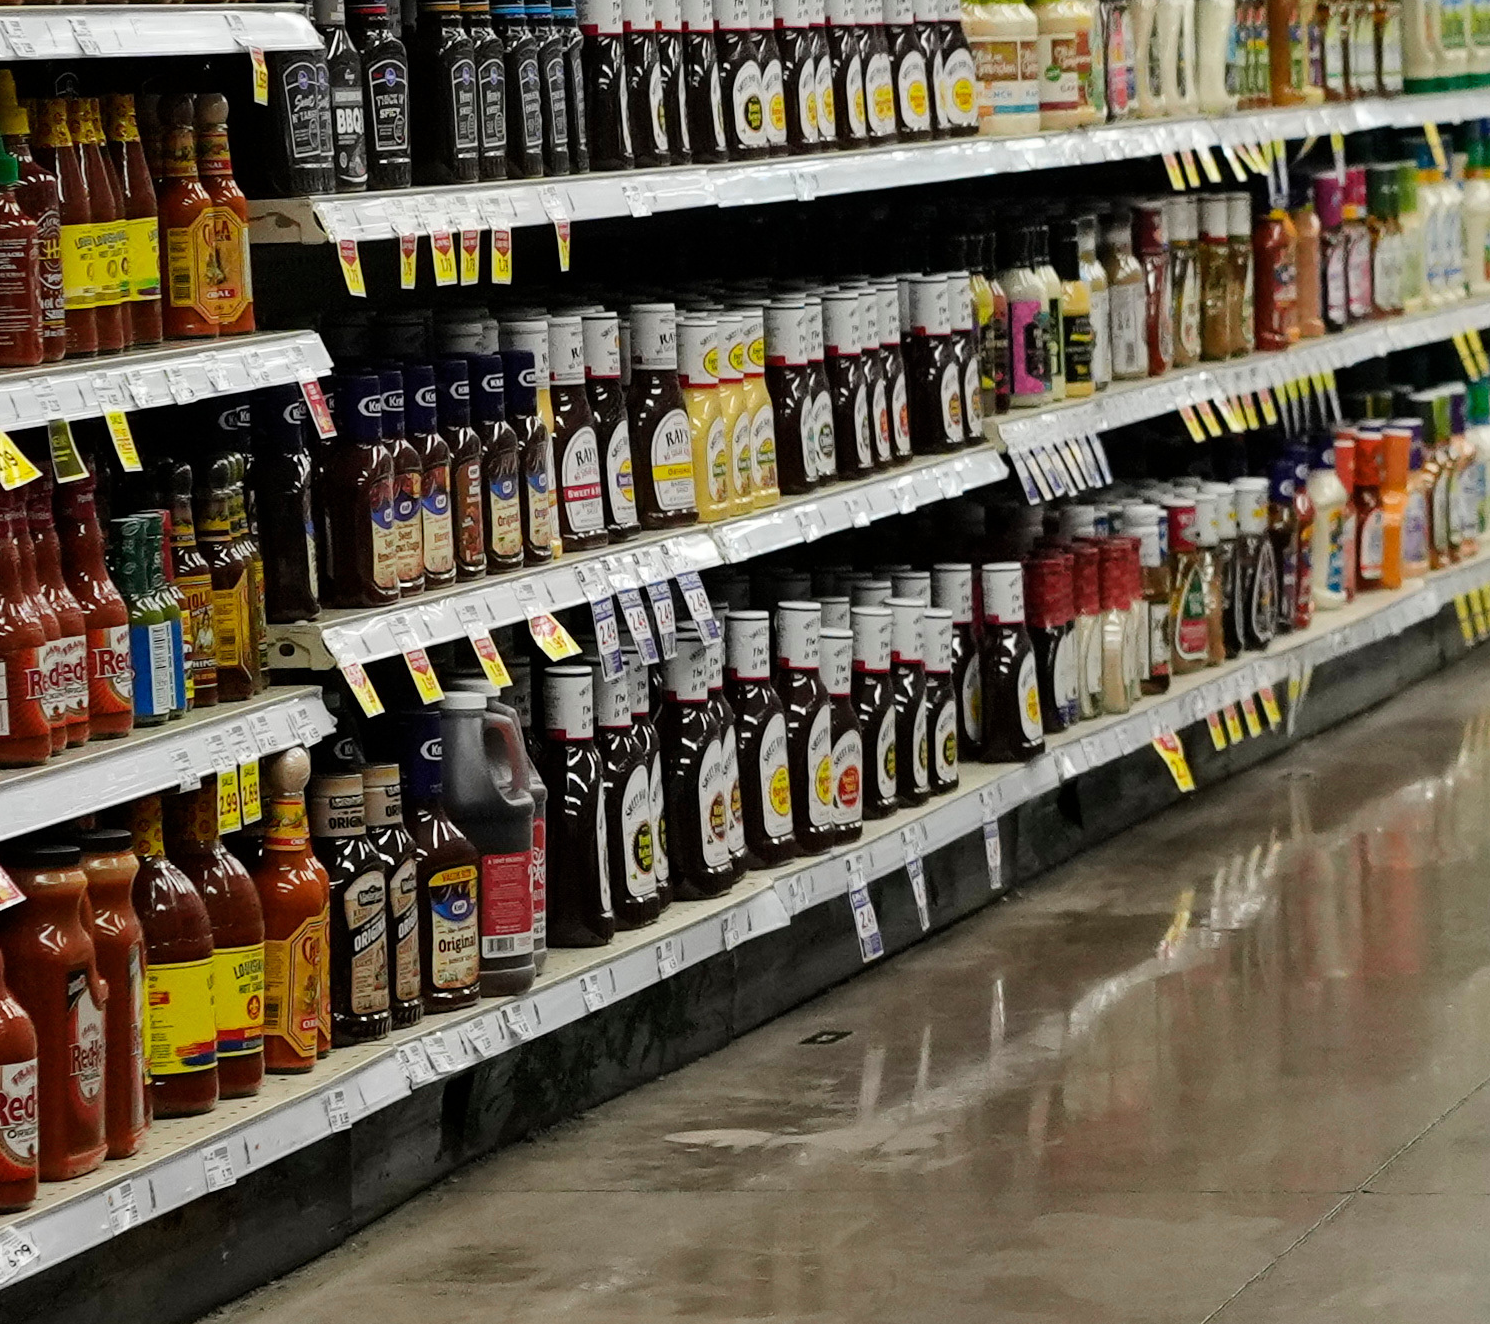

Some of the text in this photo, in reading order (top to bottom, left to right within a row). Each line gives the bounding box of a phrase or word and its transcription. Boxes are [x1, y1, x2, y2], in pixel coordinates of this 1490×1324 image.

[336, 107, 364, 135] BBQ
[241, 781, 259, 806] 2.69
[218, 796, 239, 817] 2.99
[437, 932, 476, 955] Original
